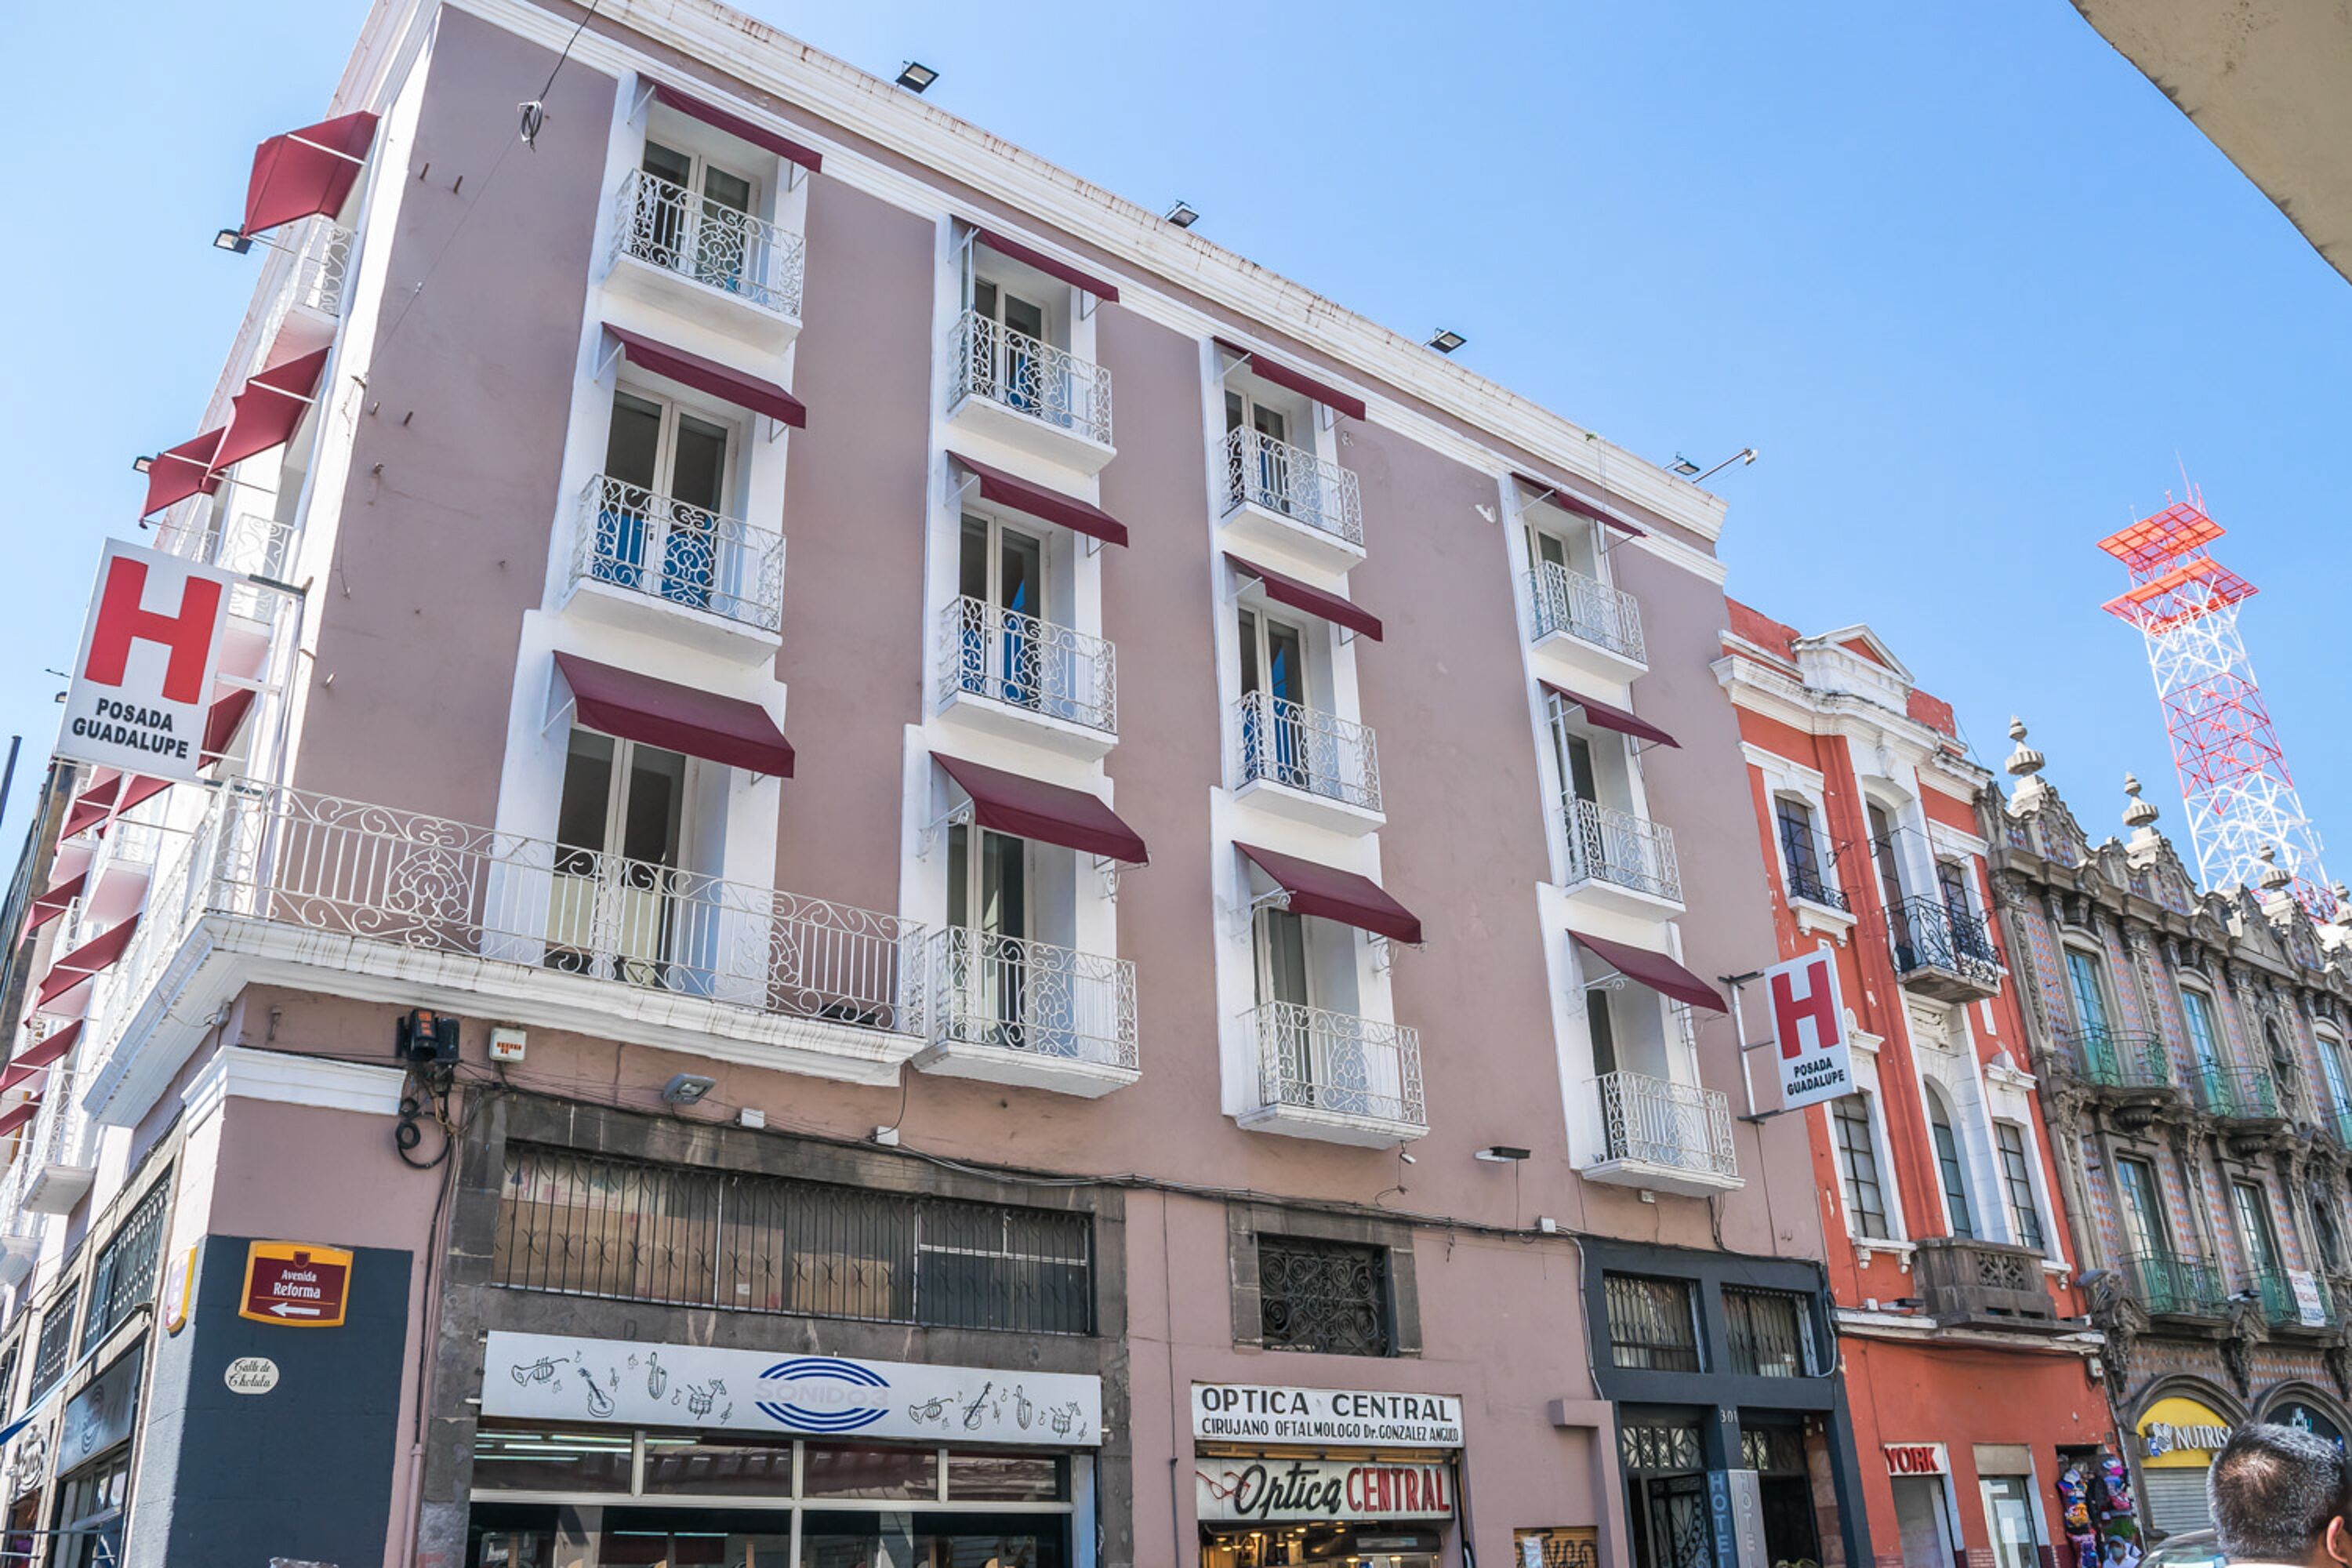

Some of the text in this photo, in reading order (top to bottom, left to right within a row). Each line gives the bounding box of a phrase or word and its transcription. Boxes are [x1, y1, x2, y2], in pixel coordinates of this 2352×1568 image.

[95, 697, 173, 731] POSADA
[72, 717, 189, 758] GUADALUPE
[1793, 1057, 1833, 1077] POSADA
[1787, 1069, 1845, 1095] GUADALUPE
[281, 1269, 318, 1283] Avenida
[273, 1282, 321, 1298] Reforma
[260, 1360, 270, 1372] de
[1201, 1387, 1453, 1422] OPTICA CENTRAL
[1201, 1417, 1269, 1436] CIRUJANO
[1275, 1421, 1361, 1439] OFTALMOLOGO
[1884, 1446, 1940, 1473] YORK
[1233, 1461, 1450, 1519] Optica CENTRAL
